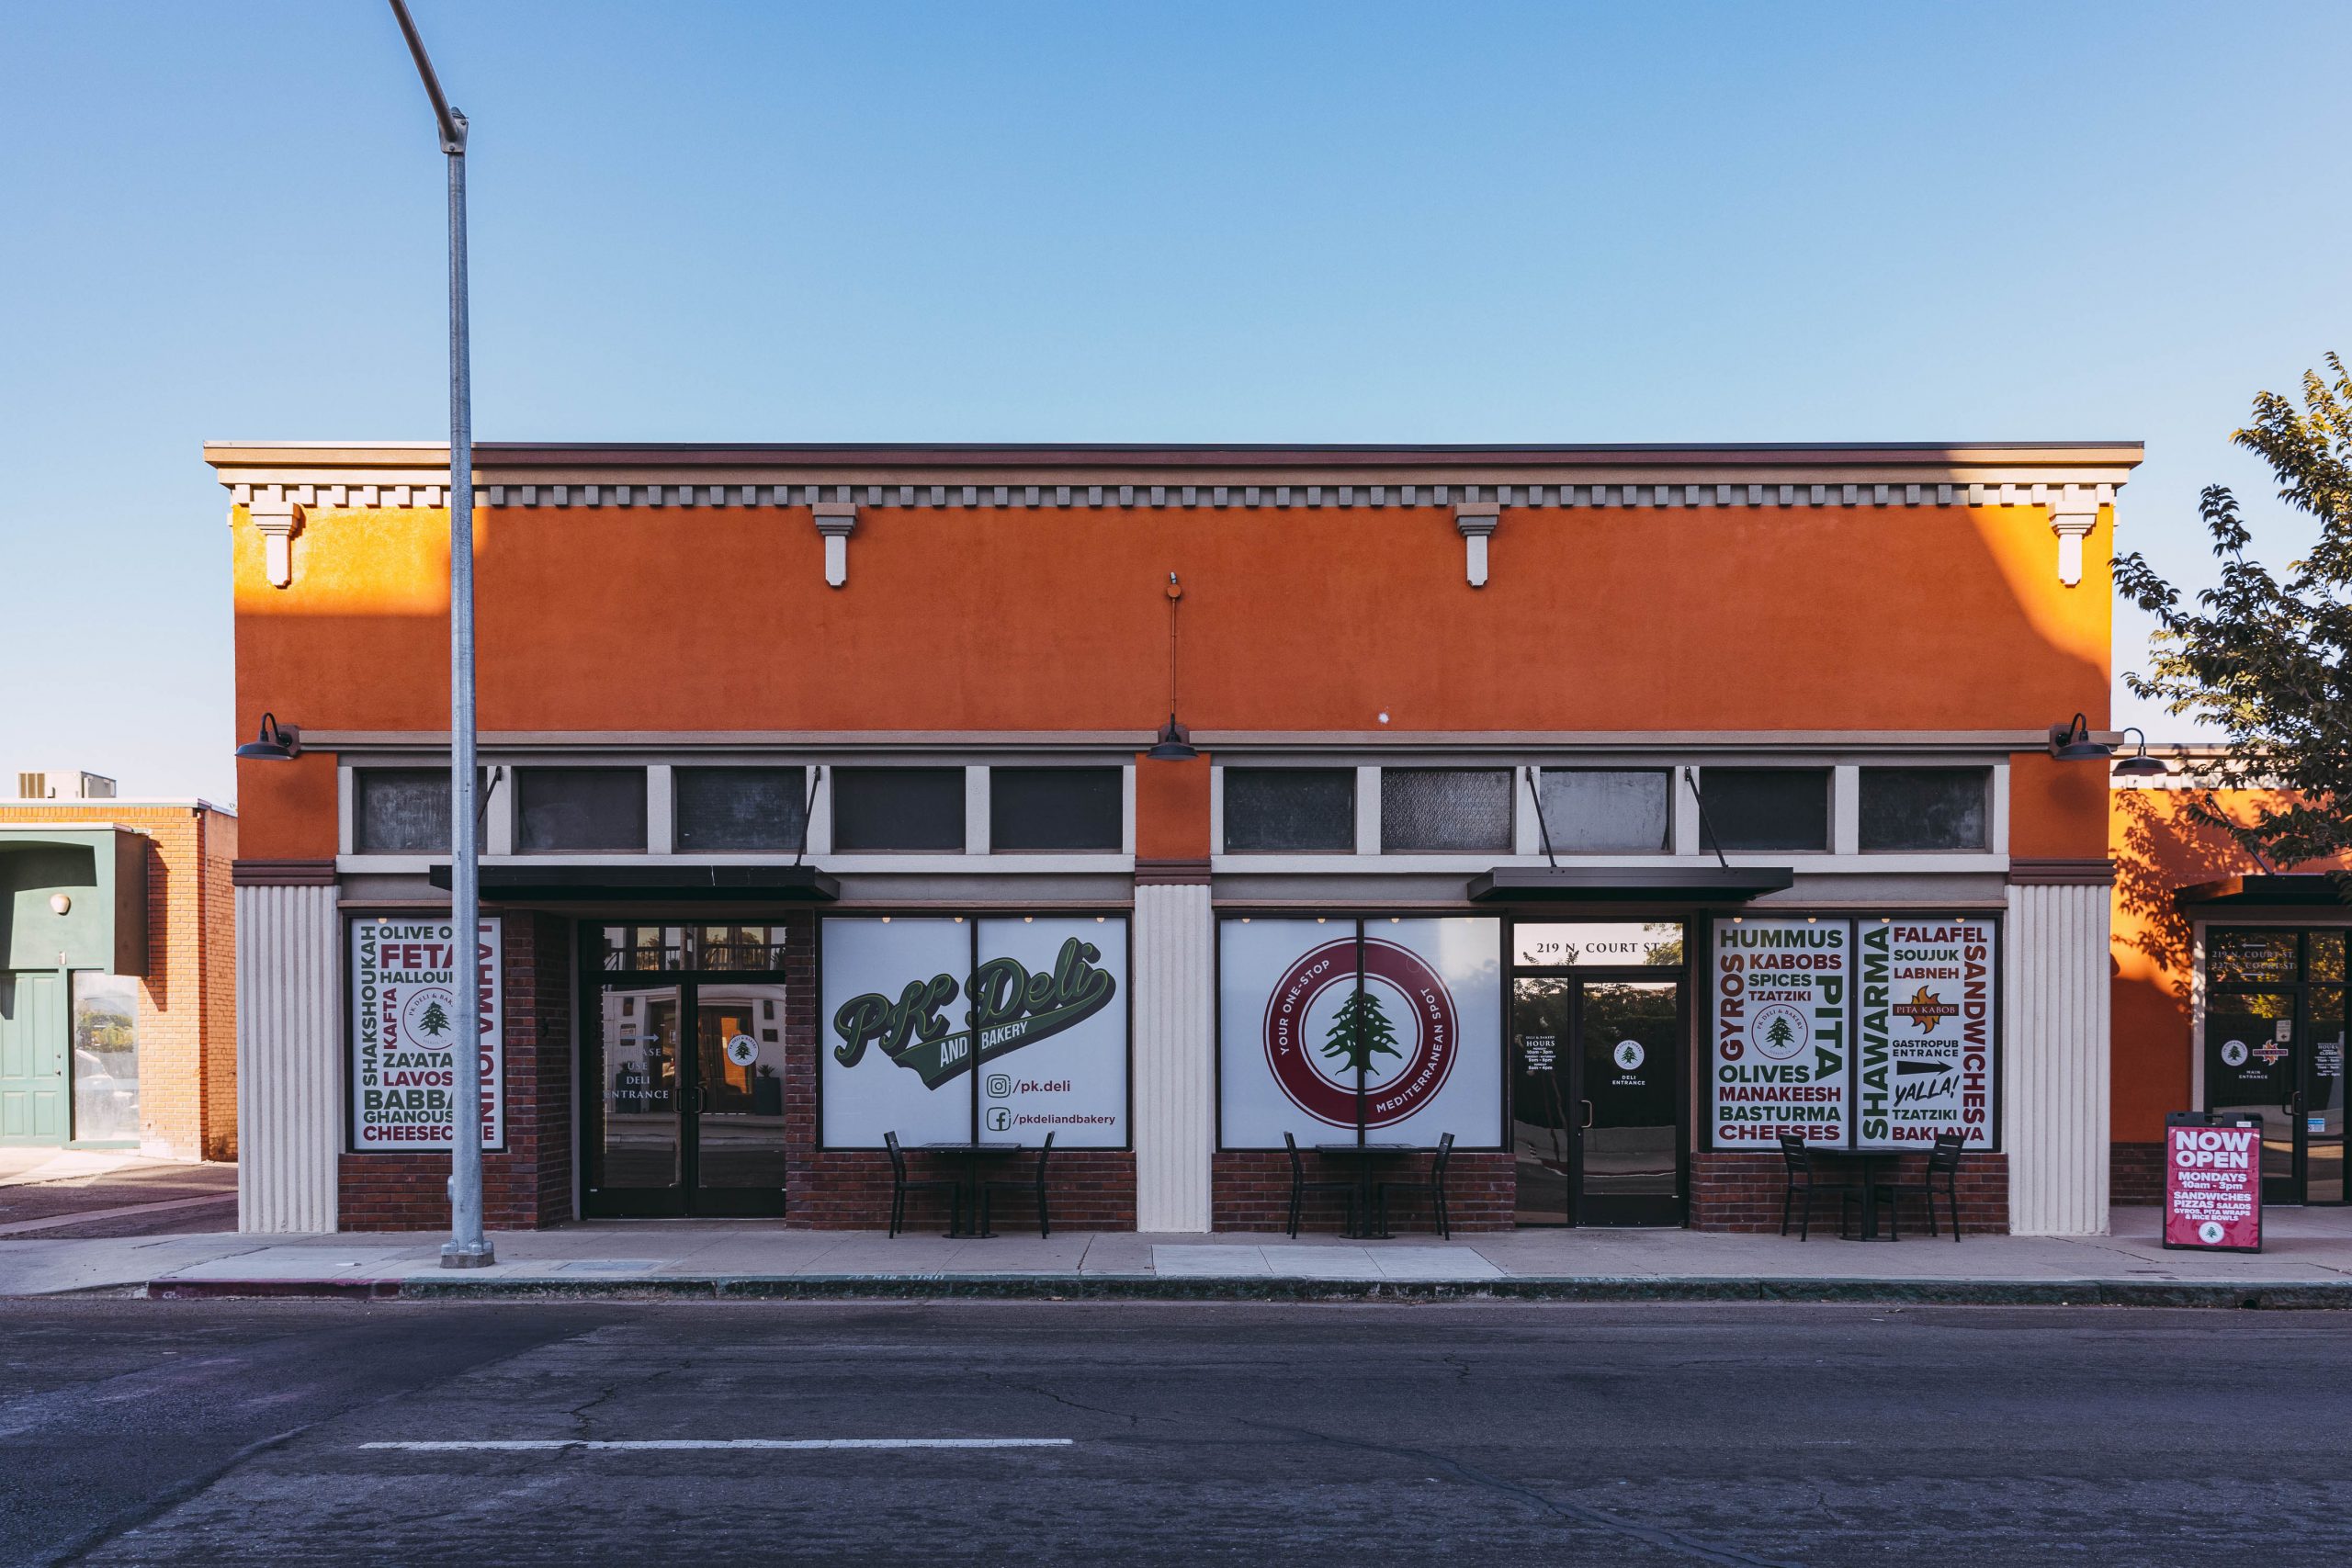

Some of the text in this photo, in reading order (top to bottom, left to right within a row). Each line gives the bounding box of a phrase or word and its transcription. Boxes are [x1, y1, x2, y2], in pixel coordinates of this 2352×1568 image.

[379, 926, 434, 940] OLIVE
[1720, 930, 1843, 948] HUMMUS
[1894, 927, 1987, 942] FALAFEL
[1537, 942, 1559, 953] 219
[1586, 942, 1638, 953] COURT
[1749, 953, 1842, 970] KABOBS
[1894, 949, 1959, 962] SOUJUK
[380, 971, 453, 983] HALLOU
[1748, 974, 1812, 987] SPICES
[1894, 967, 1959, 979] LABNEH
[965, 937, 1116, 1031] Deli
[415, 994, 430, 1007] DELI
[1748, 991, 1811, 1001] TZATZIKI
[360, 926, 377, 1087] SHAKSHOUKAH
[1279, 960, 1329, 1055] YOUR ONE-STOP
[1720, 953, 1745, 1061] GYROS
[1896, 1006, 1956, 1014] PITA KABOB
[383, 987, 398, 1049] KAFTA
[1757, 1021, 1763, 1029] PK
[1762, 1010, 1776, 1020] DELI
[1785, 1010, 1803, 1029] BAKERY
[1815, 975, 1843, 1081] PITA
[1863, 926, 1890, 1140] SHAWARMA
[1962, 945, 1986, 1124] SANDWICHES
[940, 1021, 1028, 1067] AND BAKERY
[1376, 987, 1443, 1112] MEDITERRANEAN SPOT
[1893, 1040, 1959, 1048] GASTROPUB
[383, 1053, 453, 1067] ZA'ATA
[628, 1062, 648, 1070] USE
[384, 1071, 453, 1086] LAVOS
[627, 1076, 650, 1084] DELI
[1719, 1065, 1810, 1083] OLIVES
[1012, 1079, 1070, 1094] /pk.deli
[1894, 1075, 1960, 1108] YALLA!
[364, 1089, 453, 1110] BABB
[604, 1090, 669, 1099] ENTRANCE
[1719, 1087, 1841, 1102] MANAKEESH
[364, 1111, 453, 1123] GHANOUS
[1012, 1114, 1115, 1125] /pkdeliandbakery
[1719, 1106, 1841, 1122] BASTURMA
[1893, 1110, 1957, 1120] TZATZIKI
[1719, 1124, 1840, 1140] CHEESES
[2176, 1131, 2252, 1151] NOW
[2176, 1151, 2248, 1168] OPEN
[2178, 1171, 2247, 1182] MONDAYS
[2219, 1182, 2243, 1191] 3pm
[2174, 1191, 2252, 1201] SANDWICHES
[2174, 1200, 2214, 1209] PIZZAS
